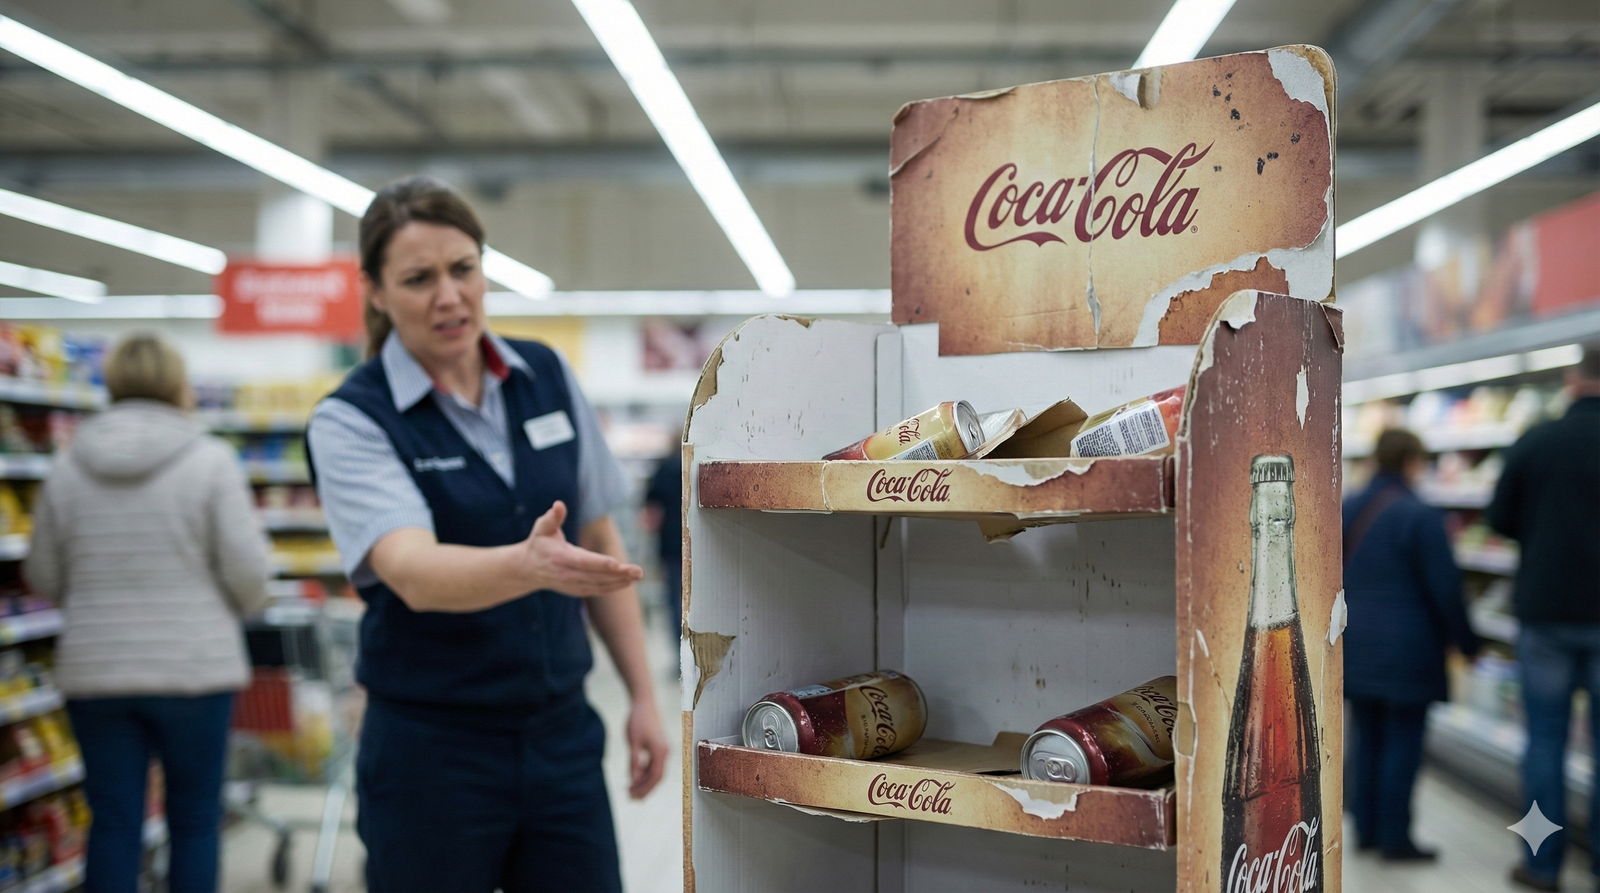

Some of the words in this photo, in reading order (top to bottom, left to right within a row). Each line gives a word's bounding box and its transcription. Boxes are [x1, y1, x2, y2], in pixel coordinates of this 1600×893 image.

[964, 140, 1214, 252] Coca-Cola
[866, 468, 953, 503] Coca-Cola
[867, 773, 956, 815] Coca-Cola
[1226, 814, 1320, 893] Coca-Cola
